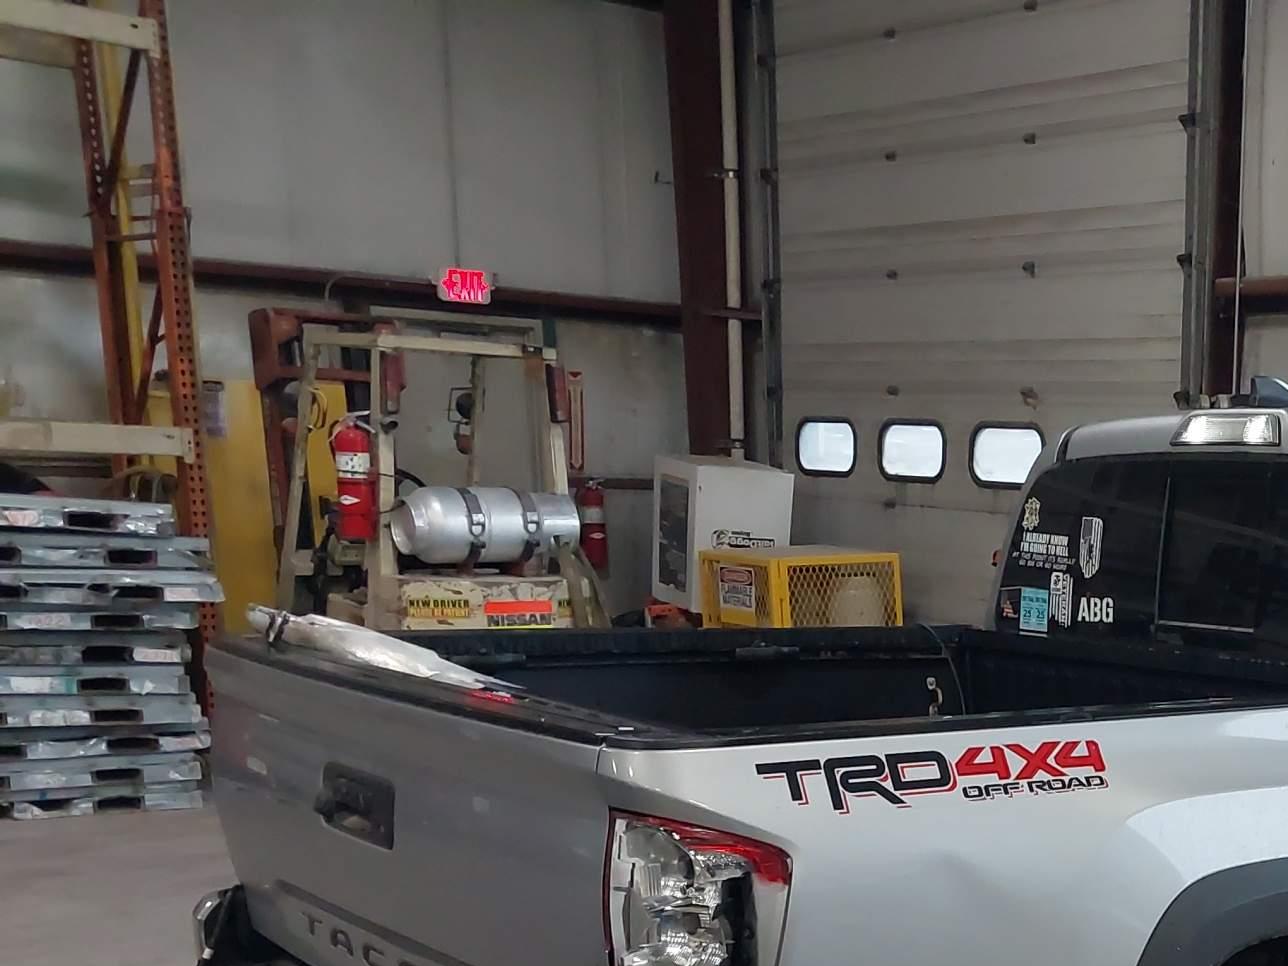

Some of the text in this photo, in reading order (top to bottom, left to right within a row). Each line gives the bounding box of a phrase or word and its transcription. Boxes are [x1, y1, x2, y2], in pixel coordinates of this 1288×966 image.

[447, 269, 485, 302] EXIT
[1026, 531, 1051, 544] ALREADY
[1050, 534, 1069, 546] KNOW
[1030, 543, 1048, 554] GOING
[1048, 544, 1056, 555] TO
[1056, 545, 1069, 557] HELL
[409, 599, 470, 608] NEW DRIVER
[1078, 597, 1114, 623] ABG
[487, 613, 552, 627] NISSAN
[755, 750, 956, 814] TRD
[962, 775, 1109, 800] OFF ROAD
